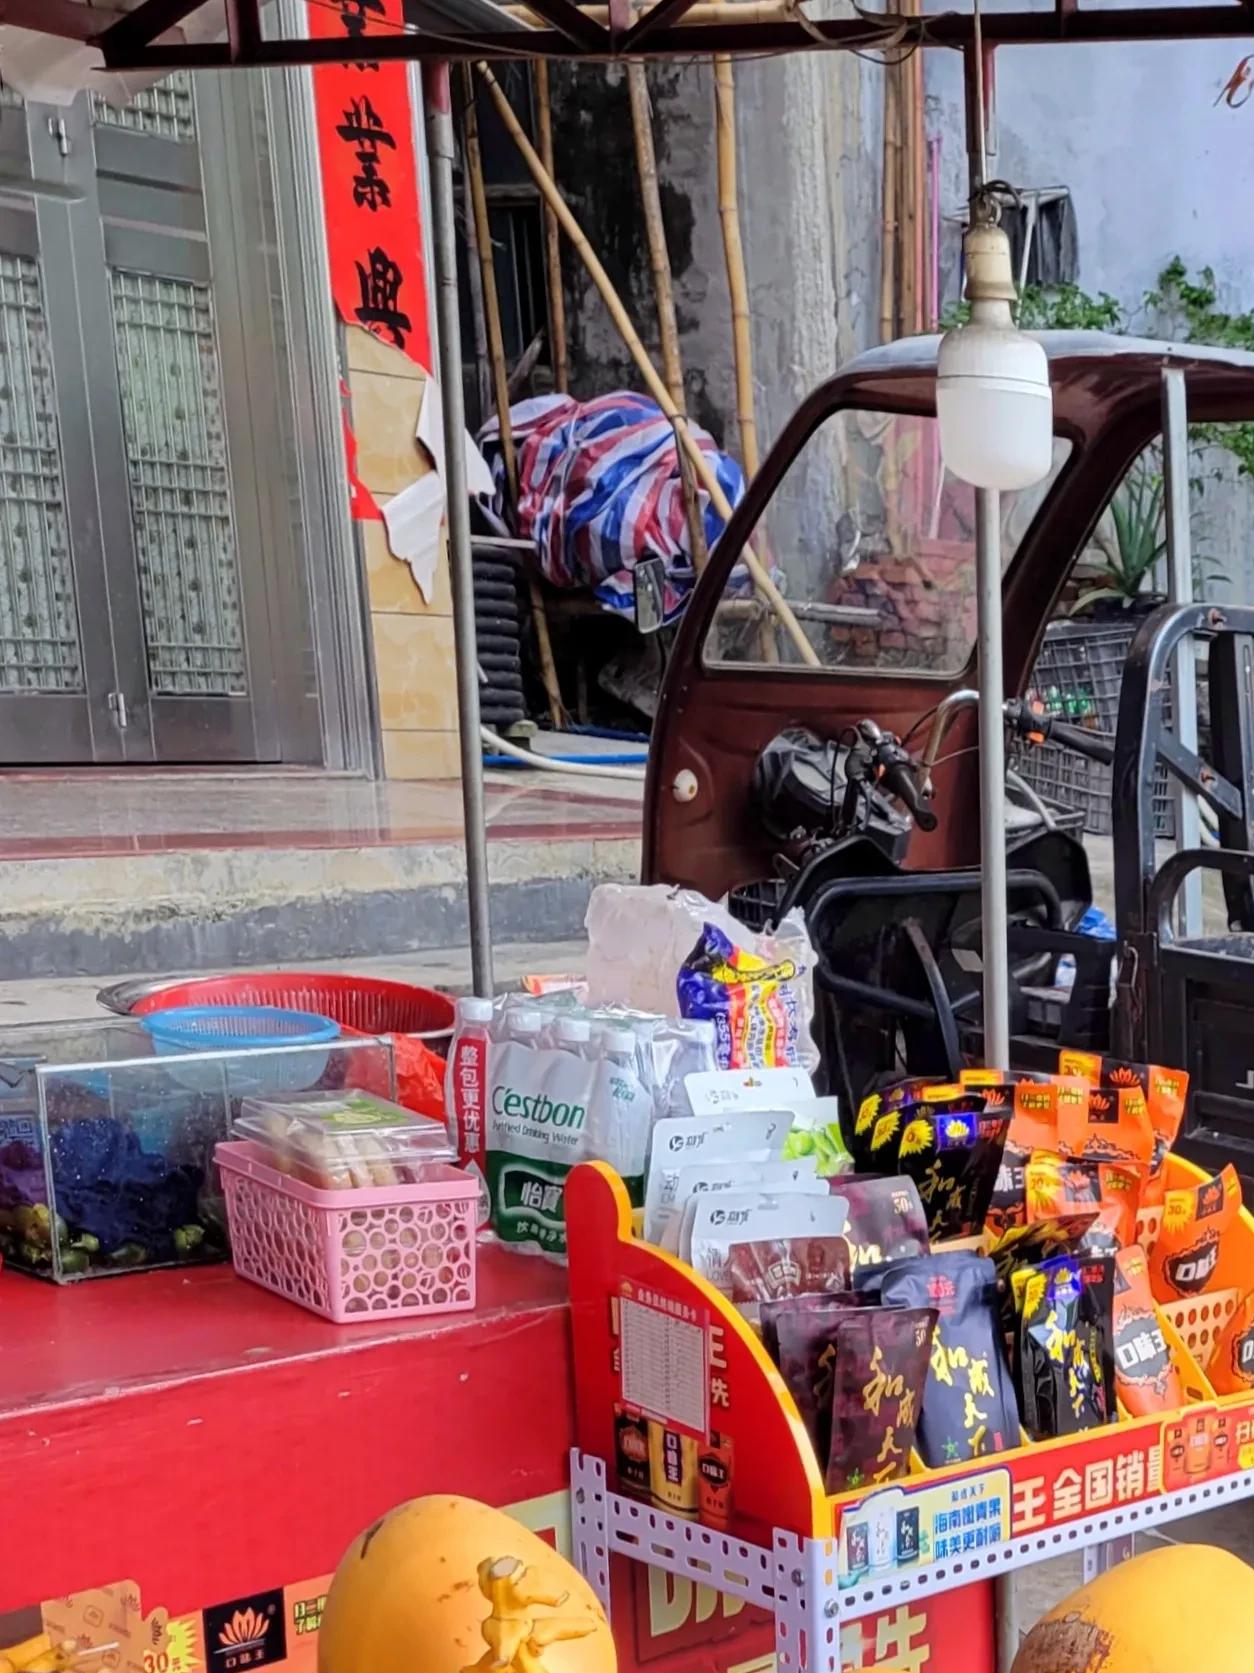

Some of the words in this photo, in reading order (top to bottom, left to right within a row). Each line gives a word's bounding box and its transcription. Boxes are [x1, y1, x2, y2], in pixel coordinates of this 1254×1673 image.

[460, 1045, 480, 1153] 整包更优惠
